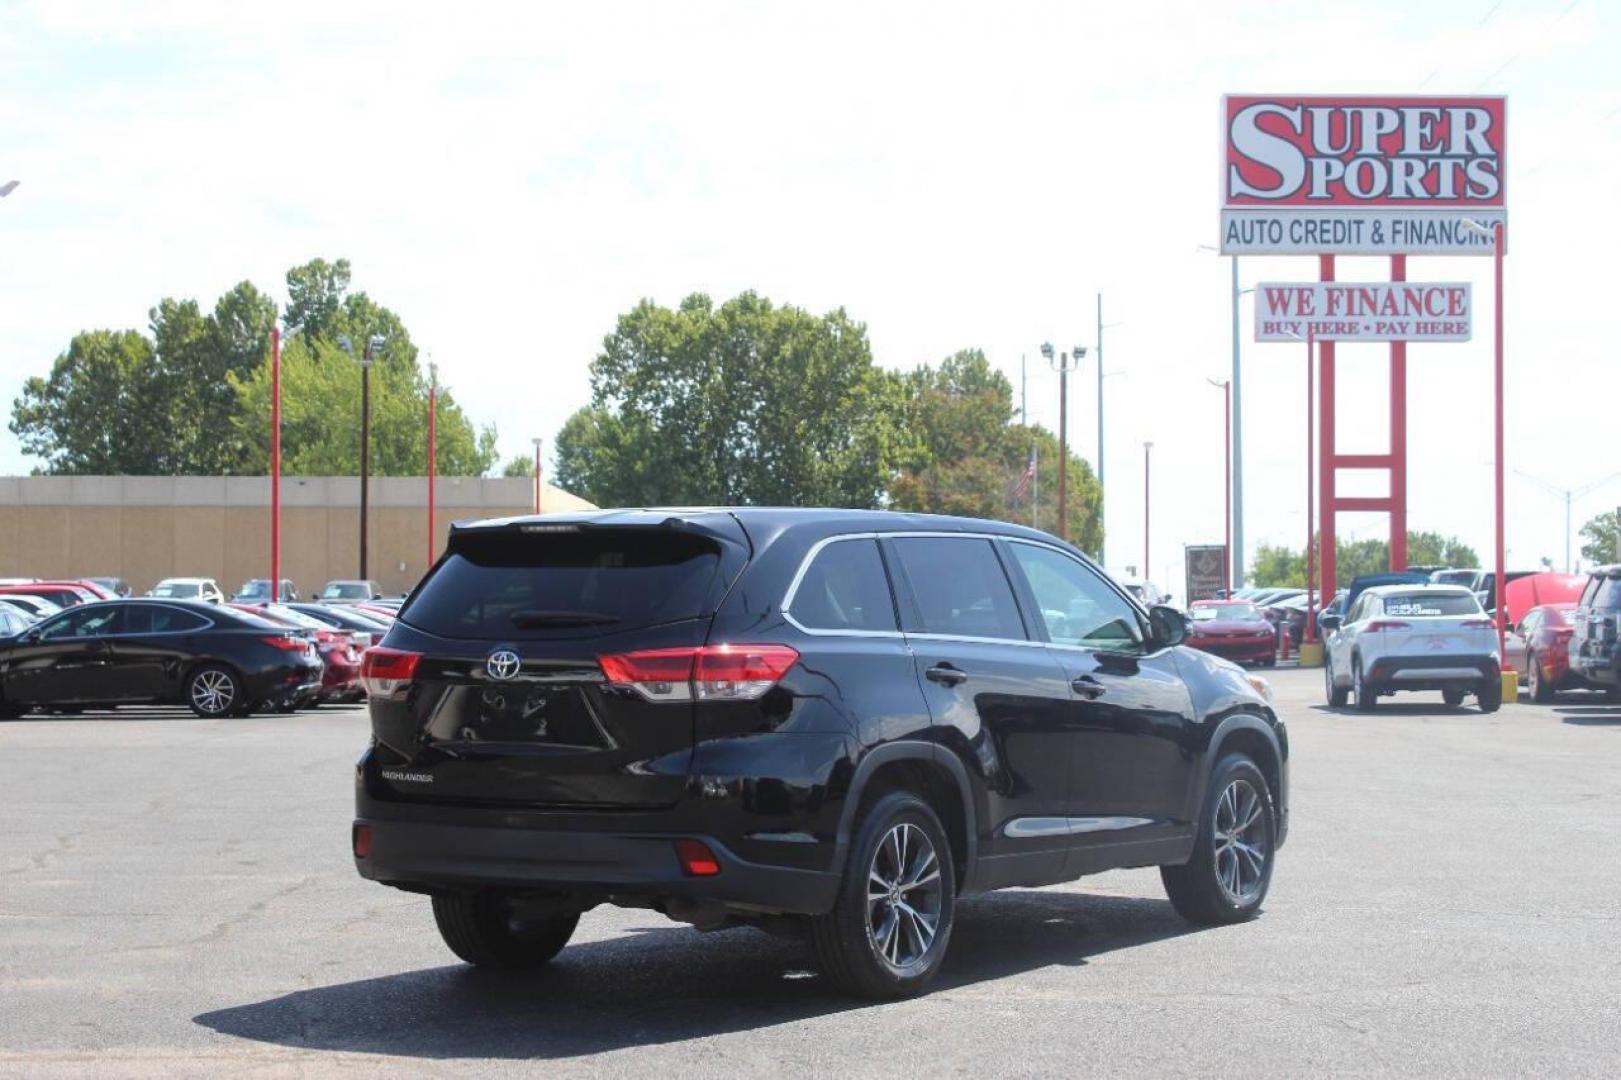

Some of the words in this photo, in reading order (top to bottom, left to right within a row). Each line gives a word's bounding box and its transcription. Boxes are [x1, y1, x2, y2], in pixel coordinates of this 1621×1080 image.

[1230, 102, 1497, 199] SUPER
[1226, 219, 1283, 245] AUTO
[1290, 219, 1365, 245] CREDIT
[1371, 219, 1385, 245] &
[1264, 287, 1315, 317] WE
[1325, 287, 1467, 317] FINANCE
[1263, 321, 1302, 335] BUY
[1307, 321, 1360, 335] HERE
[1375, 321, 1412, 335] PAY
[1415, 321, 1469, 335] HERE
[382, 770, 433, 782] HIGHLANDER
